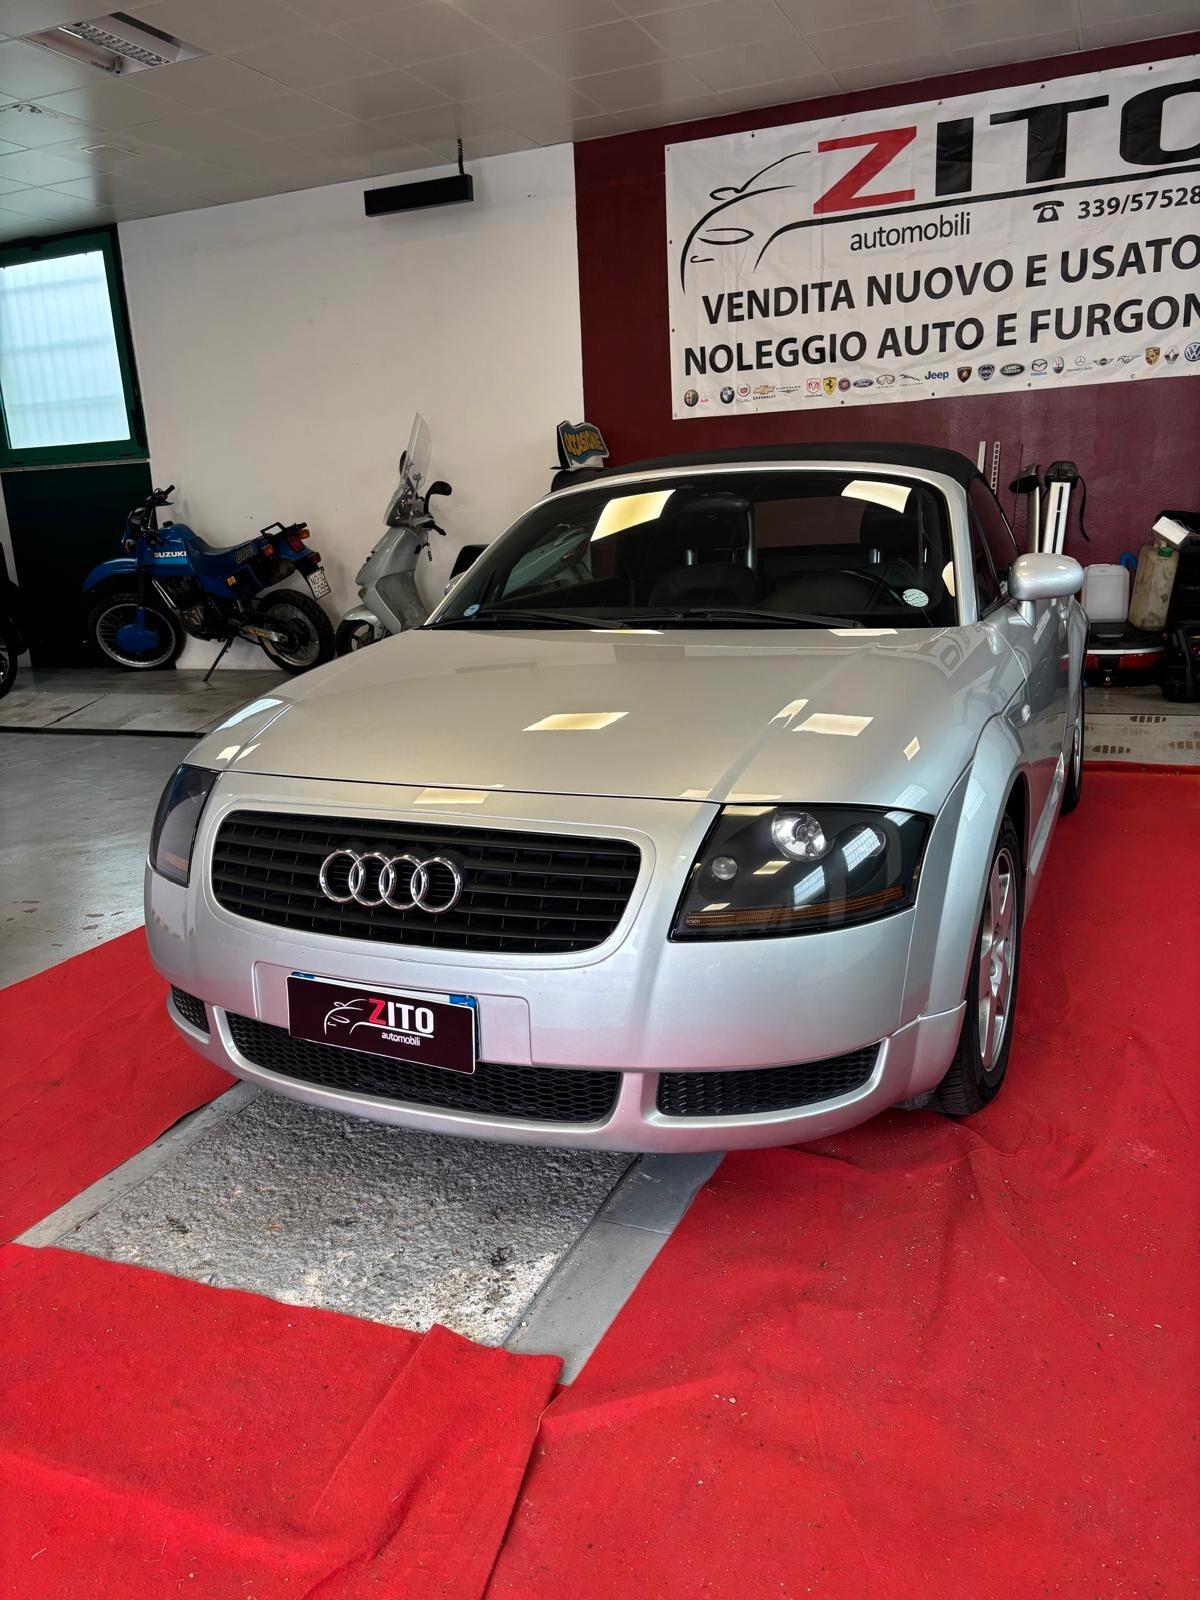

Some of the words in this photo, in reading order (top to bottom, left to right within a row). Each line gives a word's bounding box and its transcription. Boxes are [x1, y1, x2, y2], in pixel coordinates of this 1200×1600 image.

[813, 78, 1200, 214] ZITO
[1078, 185, 1200, 219] 339/57528
[850, 212, 971, 251] automobili
[702, 279, 854, 325] VENDITA
[867, 258, 1013, 307] NUOVO
[1026, 254, 1046, 288] E
[1060, 234, 1200, 283] USATO
[684, 331, 866, 376] NOLEGGIO
[877, 317, 984, 359] AUTO
[996, 313, 1017, 347] E
[924, 371, 949, 380] Jeep
[153, 550, 187, 558] SUZUKI
[227, 575, 237, 586] DR
[368, 998, 434, 1034] ZITO
[381, 1031, 421, 1047] automobili
